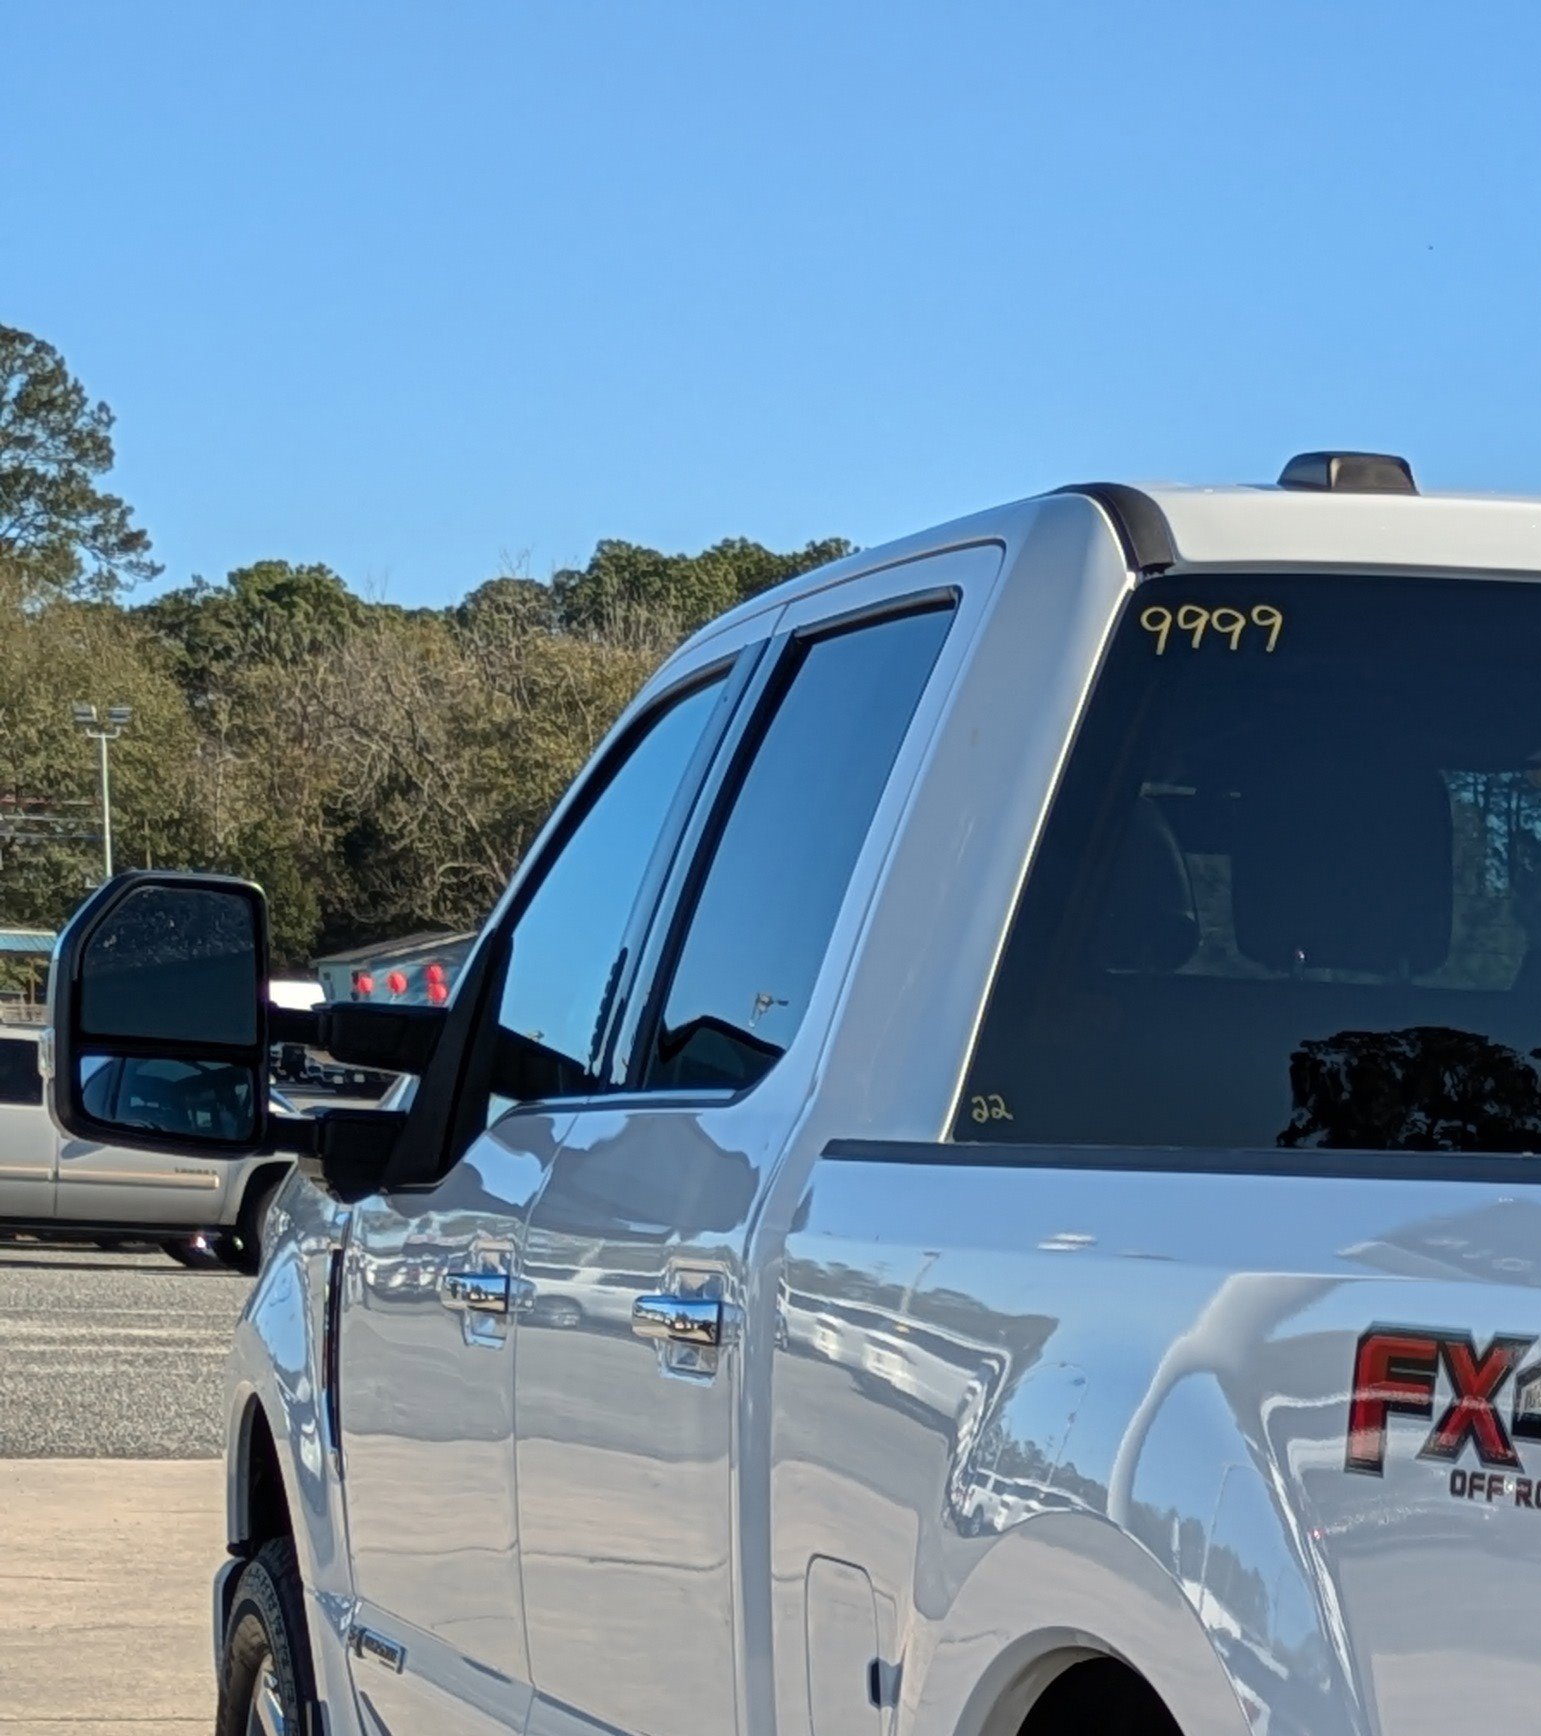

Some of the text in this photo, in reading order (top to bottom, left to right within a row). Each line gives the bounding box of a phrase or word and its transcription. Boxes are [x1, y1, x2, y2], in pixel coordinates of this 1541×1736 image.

[1140, 604, 1284, 656] 9999
[971, 1094, 1014, 1123] 22
[1450, 1468, 1505, 1503] OFF
